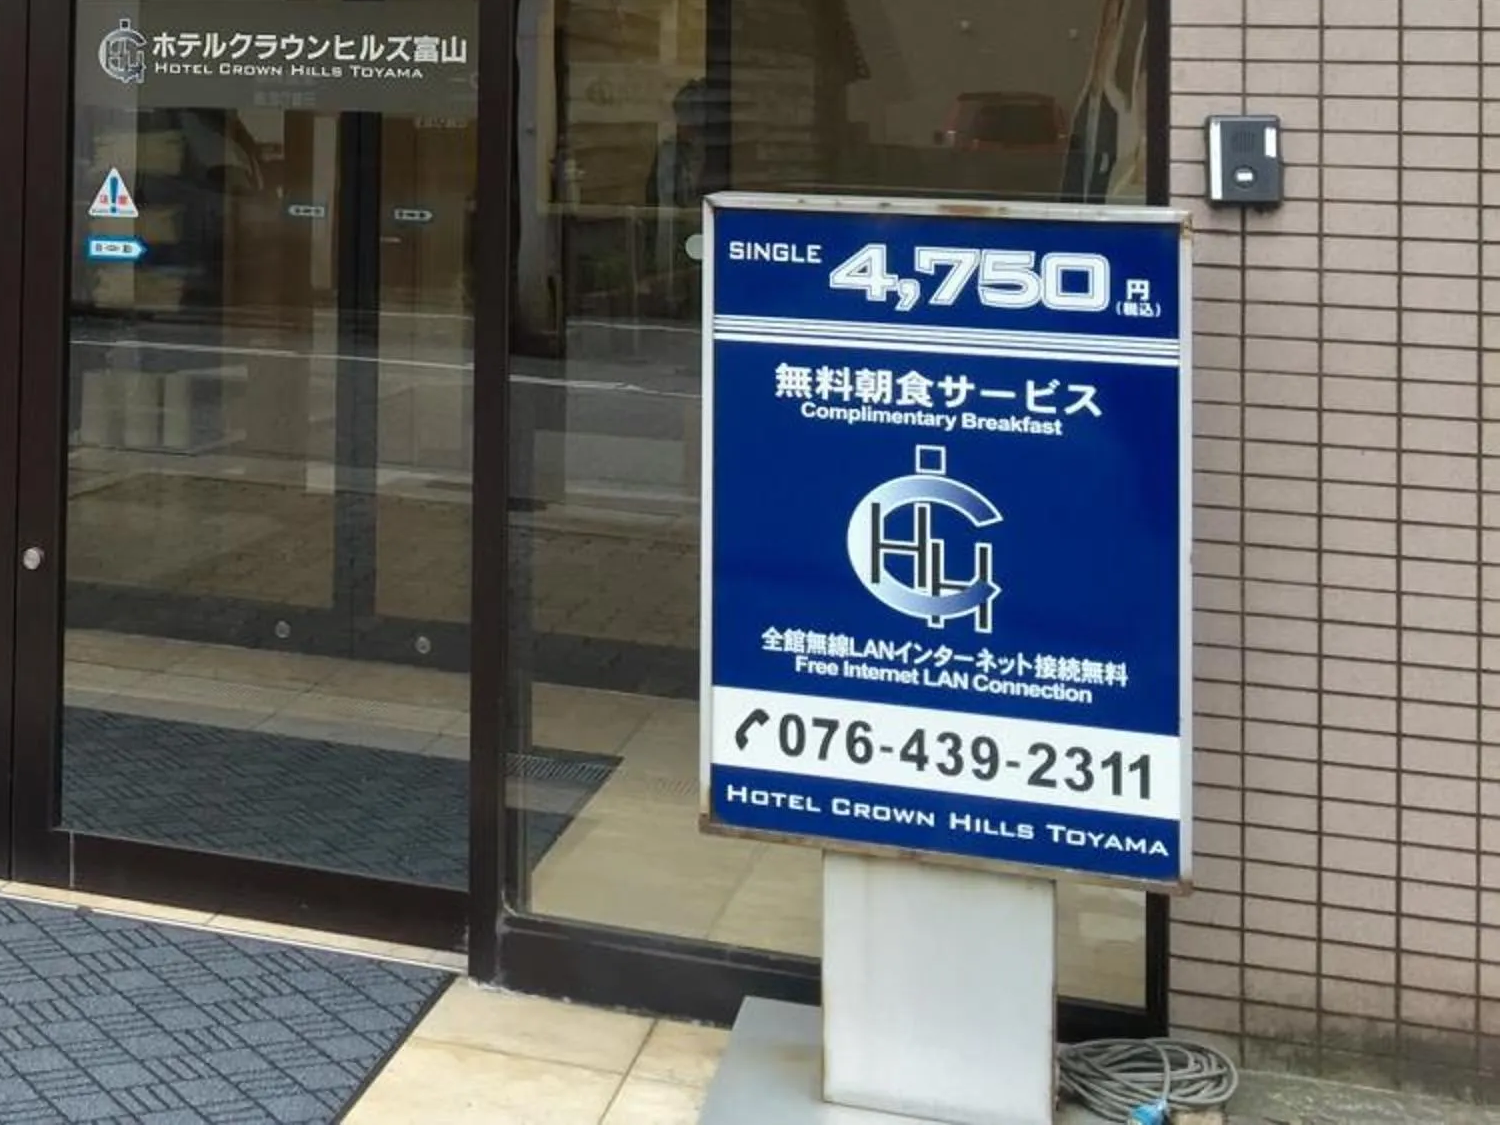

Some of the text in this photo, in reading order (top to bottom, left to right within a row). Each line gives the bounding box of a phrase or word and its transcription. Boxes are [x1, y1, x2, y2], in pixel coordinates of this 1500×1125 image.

[152, 32, 467, 63] ホテルクラウンヒルズ富山
[155, 62, 424, 79] HOTEL CROWN HILLS TOYAMA
[729, 241, 1150, 312] SINGLE 4,750 円
[775, 363, 1102, 416] 無料朝食サービス
[801, 402, 1062, 435] Complimentary Breakfast
[761, 626, 1128, 687] 全館無線LANインターネット接続無料
[795, 655, 1092, 703] Free Internet LAN Connection
[778, 714, 1151, 799] 076-439-2311
[727, 784, 1169, 856] HOTEL CROWN HILLS TOYAMA
